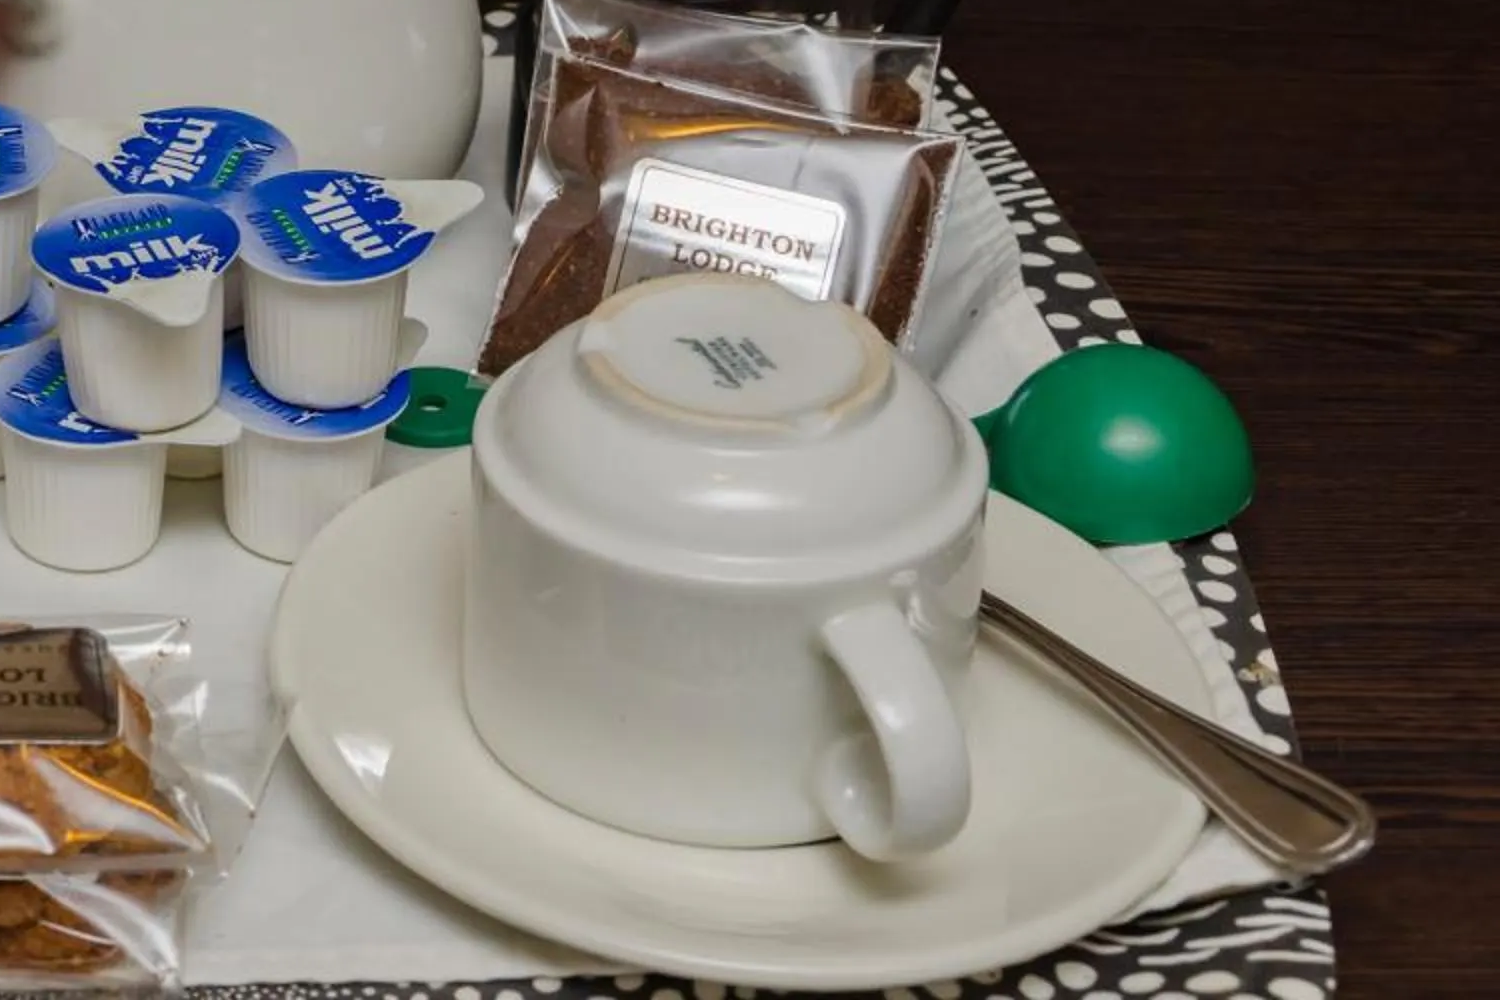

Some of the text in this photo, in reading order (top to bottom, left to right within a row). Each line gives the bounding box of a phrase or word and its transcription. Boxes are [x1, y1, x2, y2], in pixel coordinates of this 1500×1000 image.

[140, 116, 219, 188] milk
[69, 223, 205, 275] milk
[301, 181, 395, 260] milk
[651, 203, 816, 262] BRIGHTON
